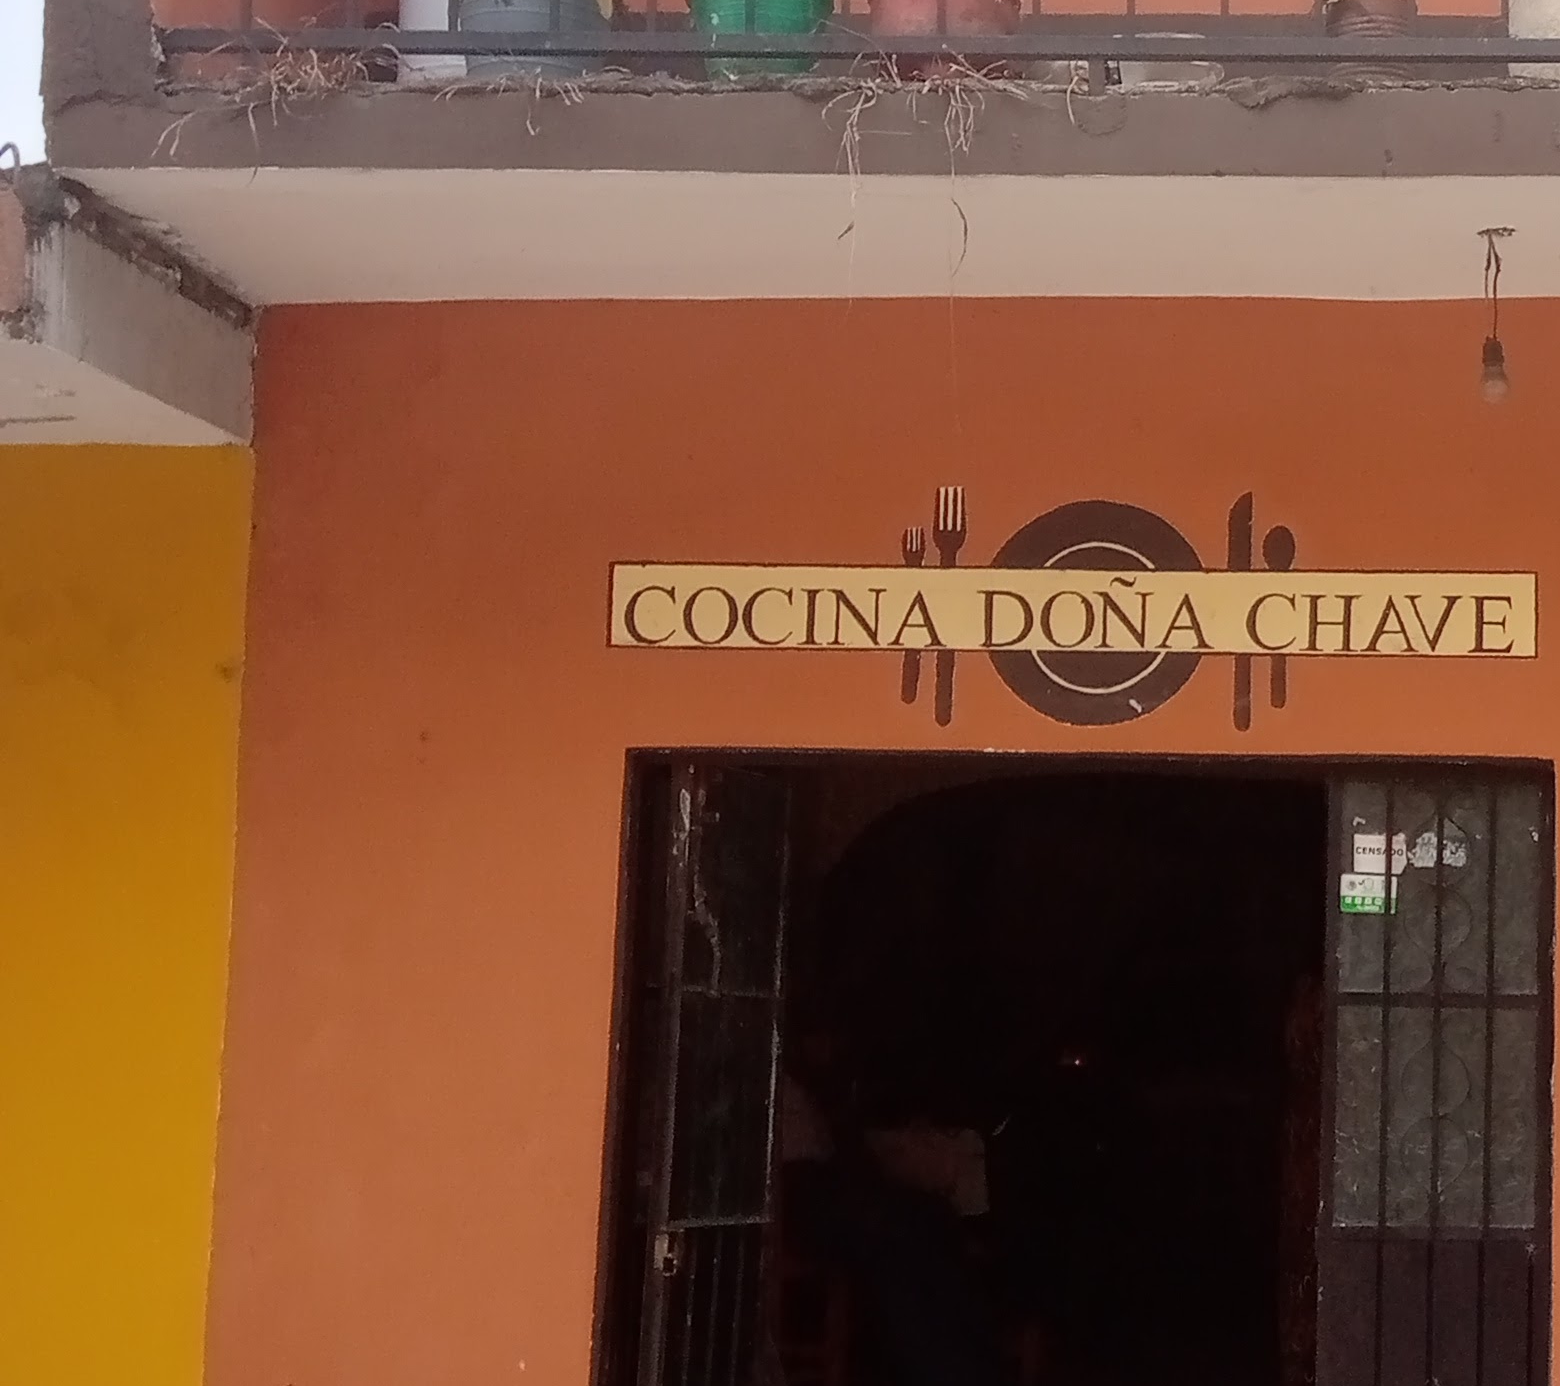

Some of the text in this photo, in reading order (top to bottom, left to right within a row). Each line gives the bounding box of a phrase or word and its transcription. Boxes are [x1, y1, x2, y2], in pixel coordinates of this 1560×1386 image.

[624, 576, 1515, 654] COCINA DOÑA CHAVE
